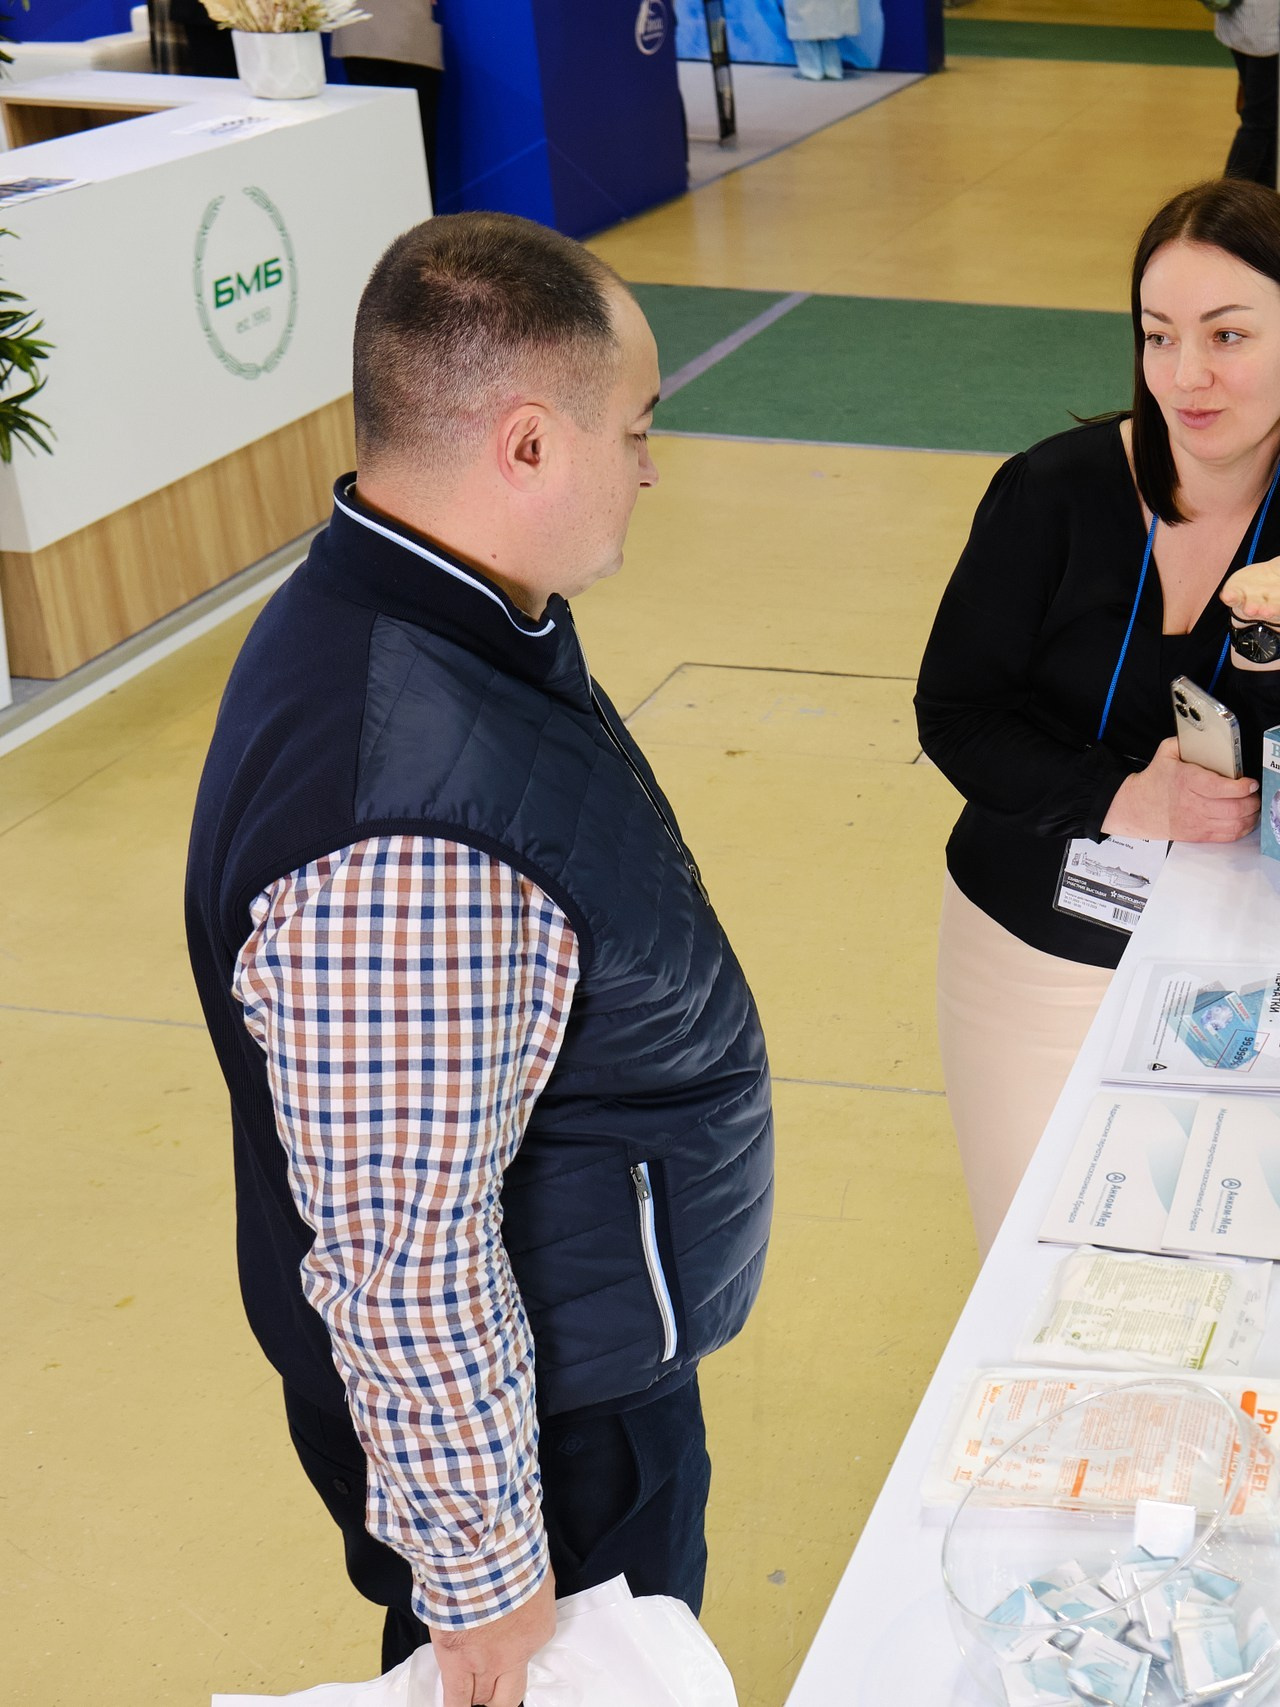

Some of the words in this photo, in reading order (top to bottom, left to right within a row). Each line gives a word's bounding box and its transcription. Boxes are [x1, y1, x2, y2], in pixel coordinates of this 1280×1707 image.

[214, 257, 282, 308] БМБ
[1229, 1036, 1254, 1066] 99.999%
[1101, 1103, 1120, 1138] Медицинские
[1211, 1107, 1227, 1142] Медицинские
[1092, 1137, 1107, 1162] перчатки
[1204, 1143, 1216, 1168] перчатки
[1077, 1162, 1097, 1200] эксклюзивных
[1194, 1167, 1210, 1206] эксклюзивных
[1067, 1199, 1086, 1224] брендов
[1094, 1184, 1122, 1228] Анком-Мед
[1188, 1206, 1203, 1231] брендов
[1215, 1190, 1238, 1235] Анком-Мед
